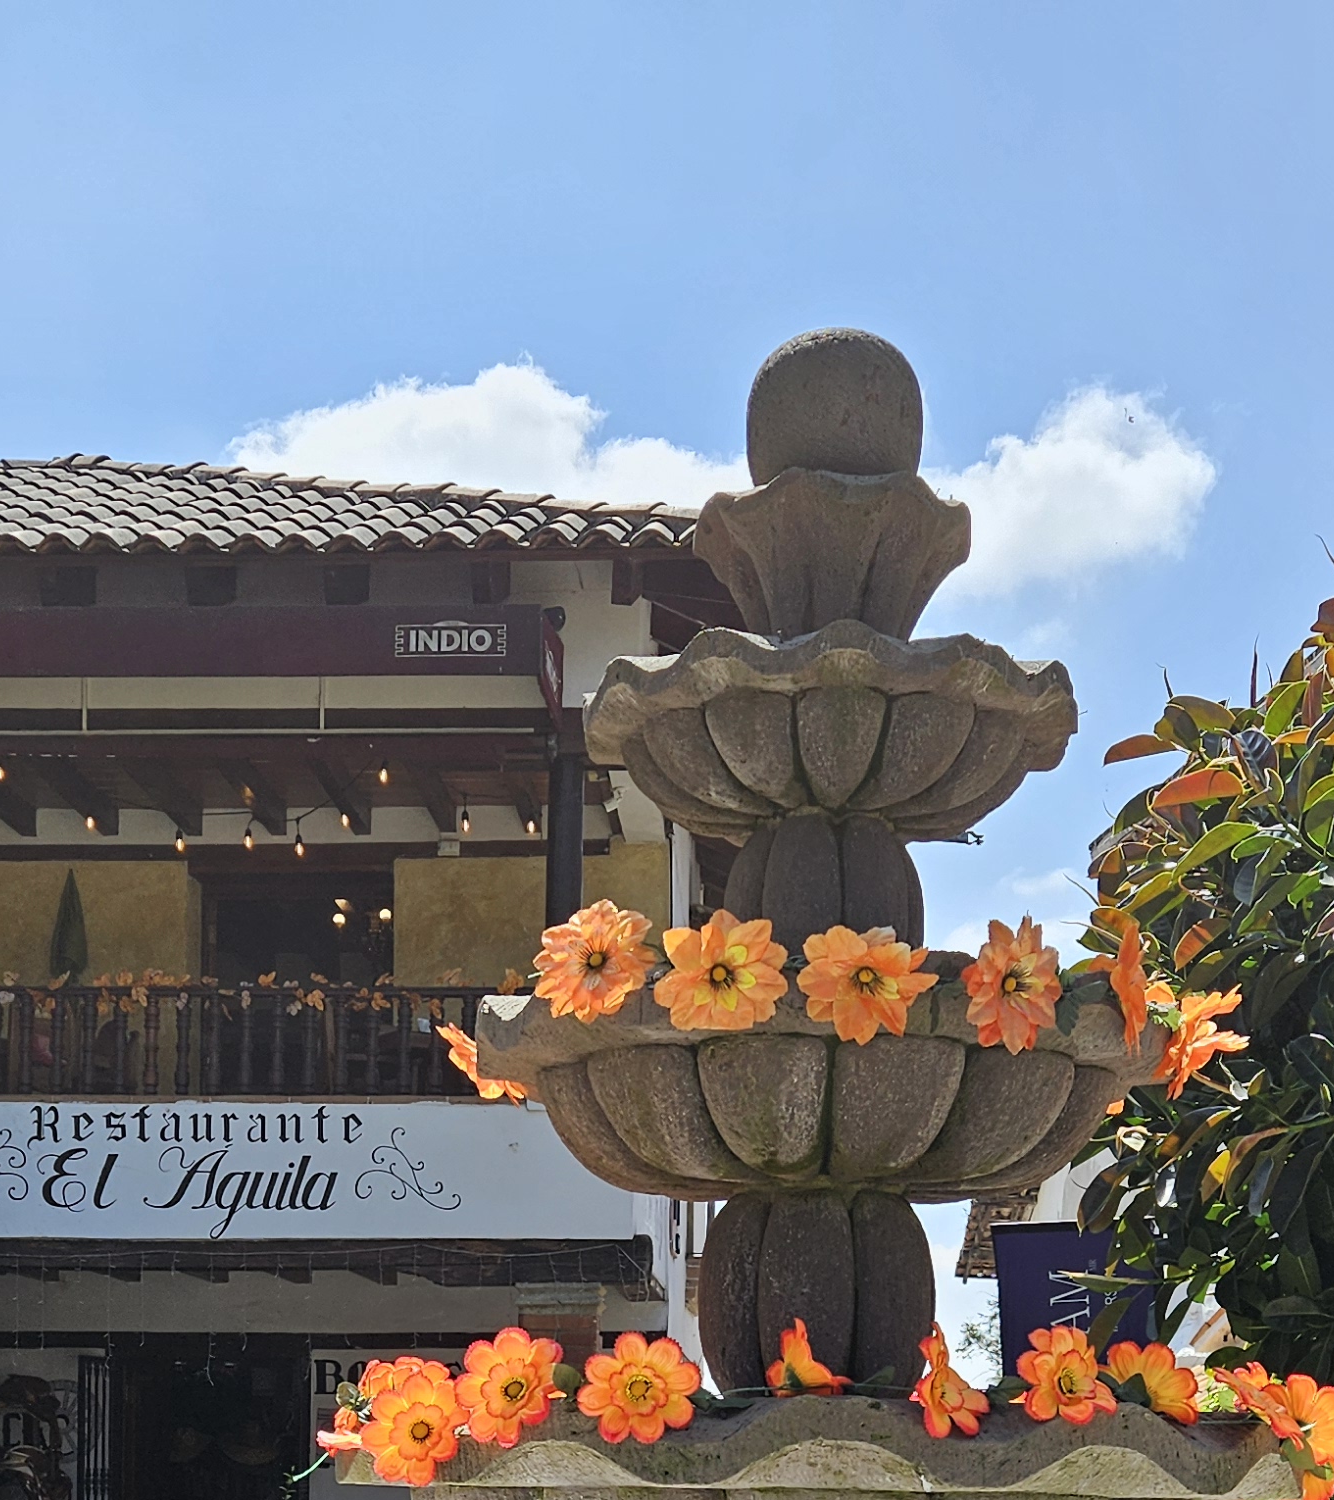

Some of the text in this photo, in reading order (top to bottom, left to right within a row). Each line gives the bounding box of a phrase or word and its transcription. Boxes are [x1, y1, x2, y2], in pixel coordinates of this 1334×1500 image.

[409, 629, 492, 652] INDIO
[27, 1105, 363, 1149] Restaurante
[37, 1144, 338, 1239] El Águila
